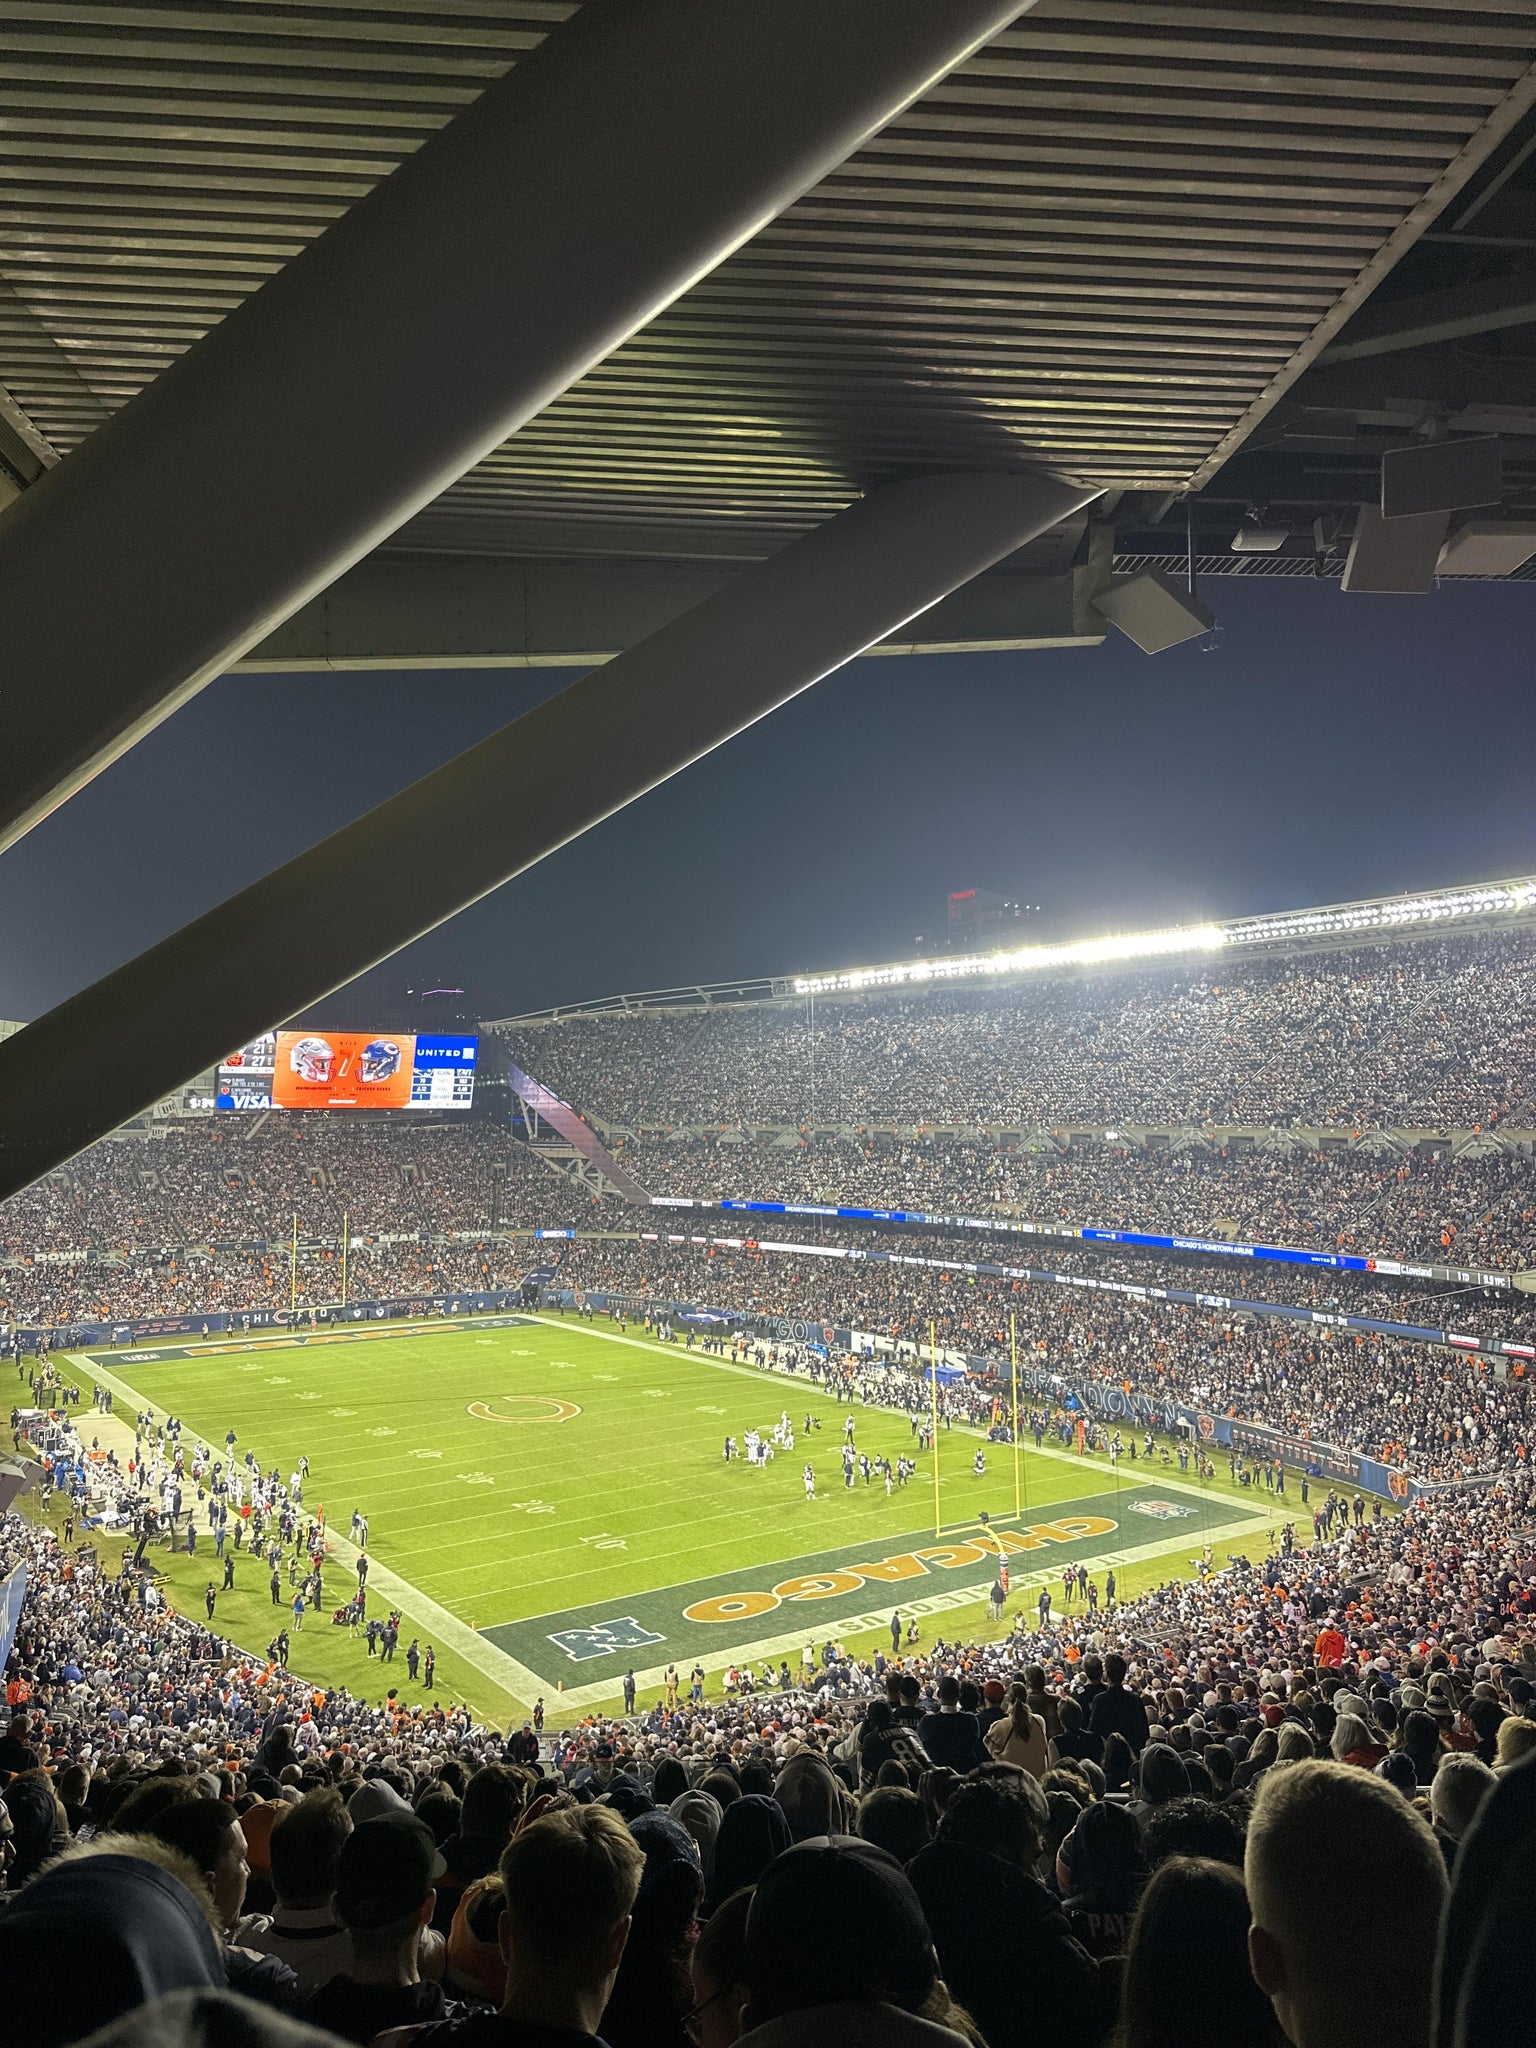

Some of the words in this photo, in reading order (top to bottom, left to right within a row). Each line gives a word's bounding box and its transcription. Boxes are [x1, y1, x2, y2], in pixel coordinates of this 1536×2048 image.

[252, 1043, 265, 1055] 21
[251, 1055, 265, 1067] 27
[230, 1096, 270, 1109] VISA
[379, 1233, 420, 1242] BEAR
[454, 1230, 492, 1239] DOWN
[1201, 1243, 1234, 1254] HOMETOWN
[34, 1250, 88, 1261] DOWN
[579, 1532, 628, 1550] 10
[682, 1515, 1120, 1623] CHICAGO
[937, 1586, 992, 1604] ALL
[899, 1602, 934, 1618] OF
[837, 1615, 887, 1631] US
